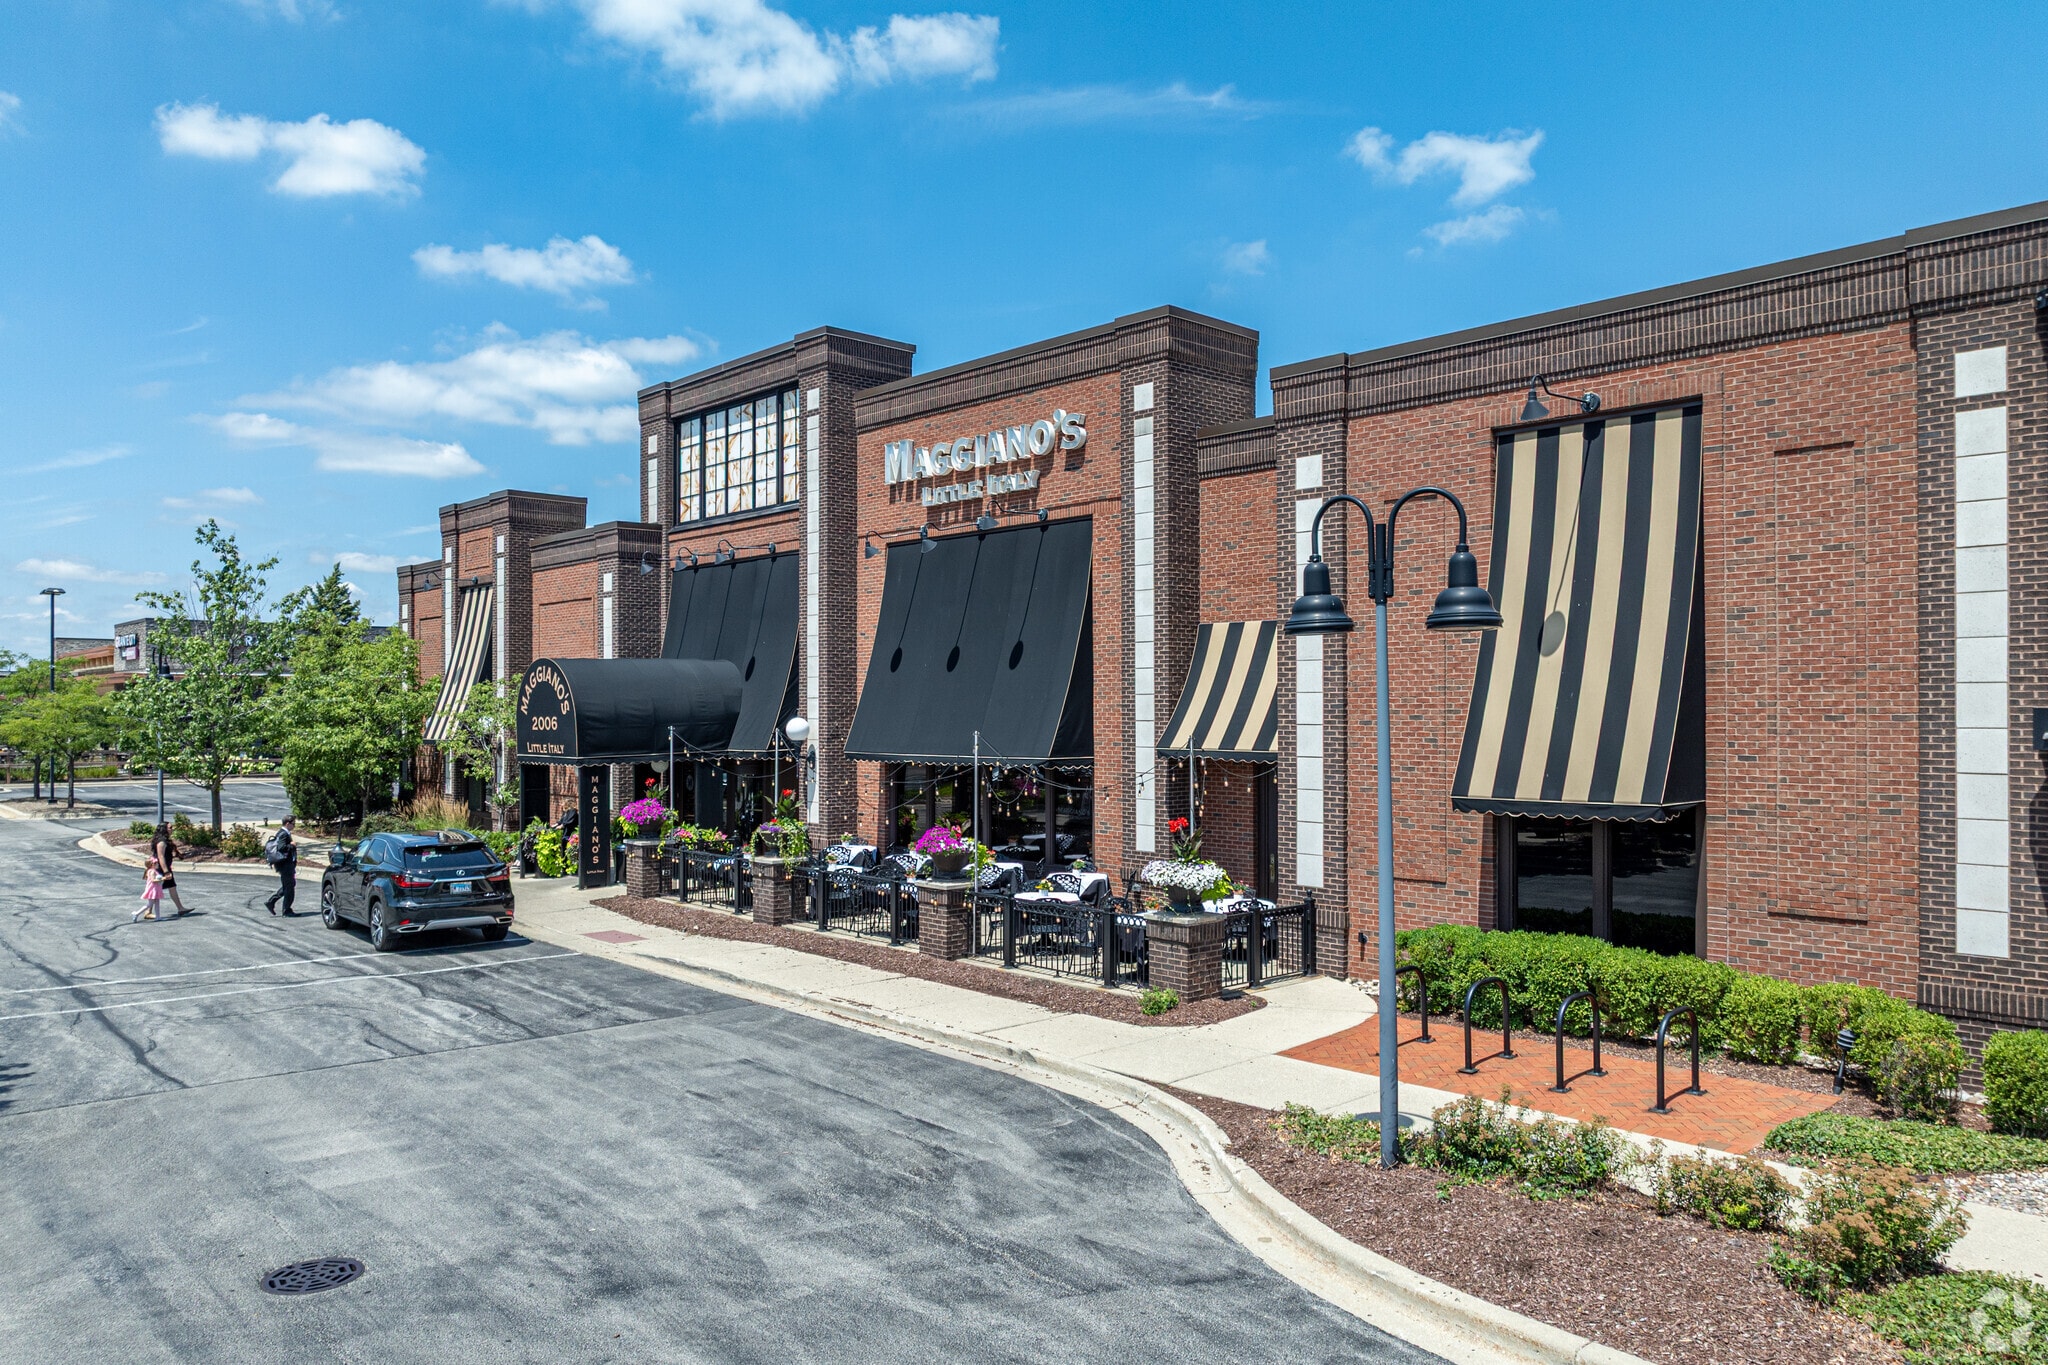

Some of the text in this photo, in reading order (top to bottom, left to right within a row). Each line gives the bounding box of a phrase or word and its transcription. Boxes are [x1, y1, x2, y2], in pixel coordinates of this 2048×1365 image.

[884, 408, 1087, 485] MAGGIANO'S
[921, 470, 1041, 507] LITTLE ITALY
[520, 665, 570, 716] MAGGIANO'S
[531, 716, 558, 731] 2006
[526, 742, 565, 754] LITTLE ITALY
